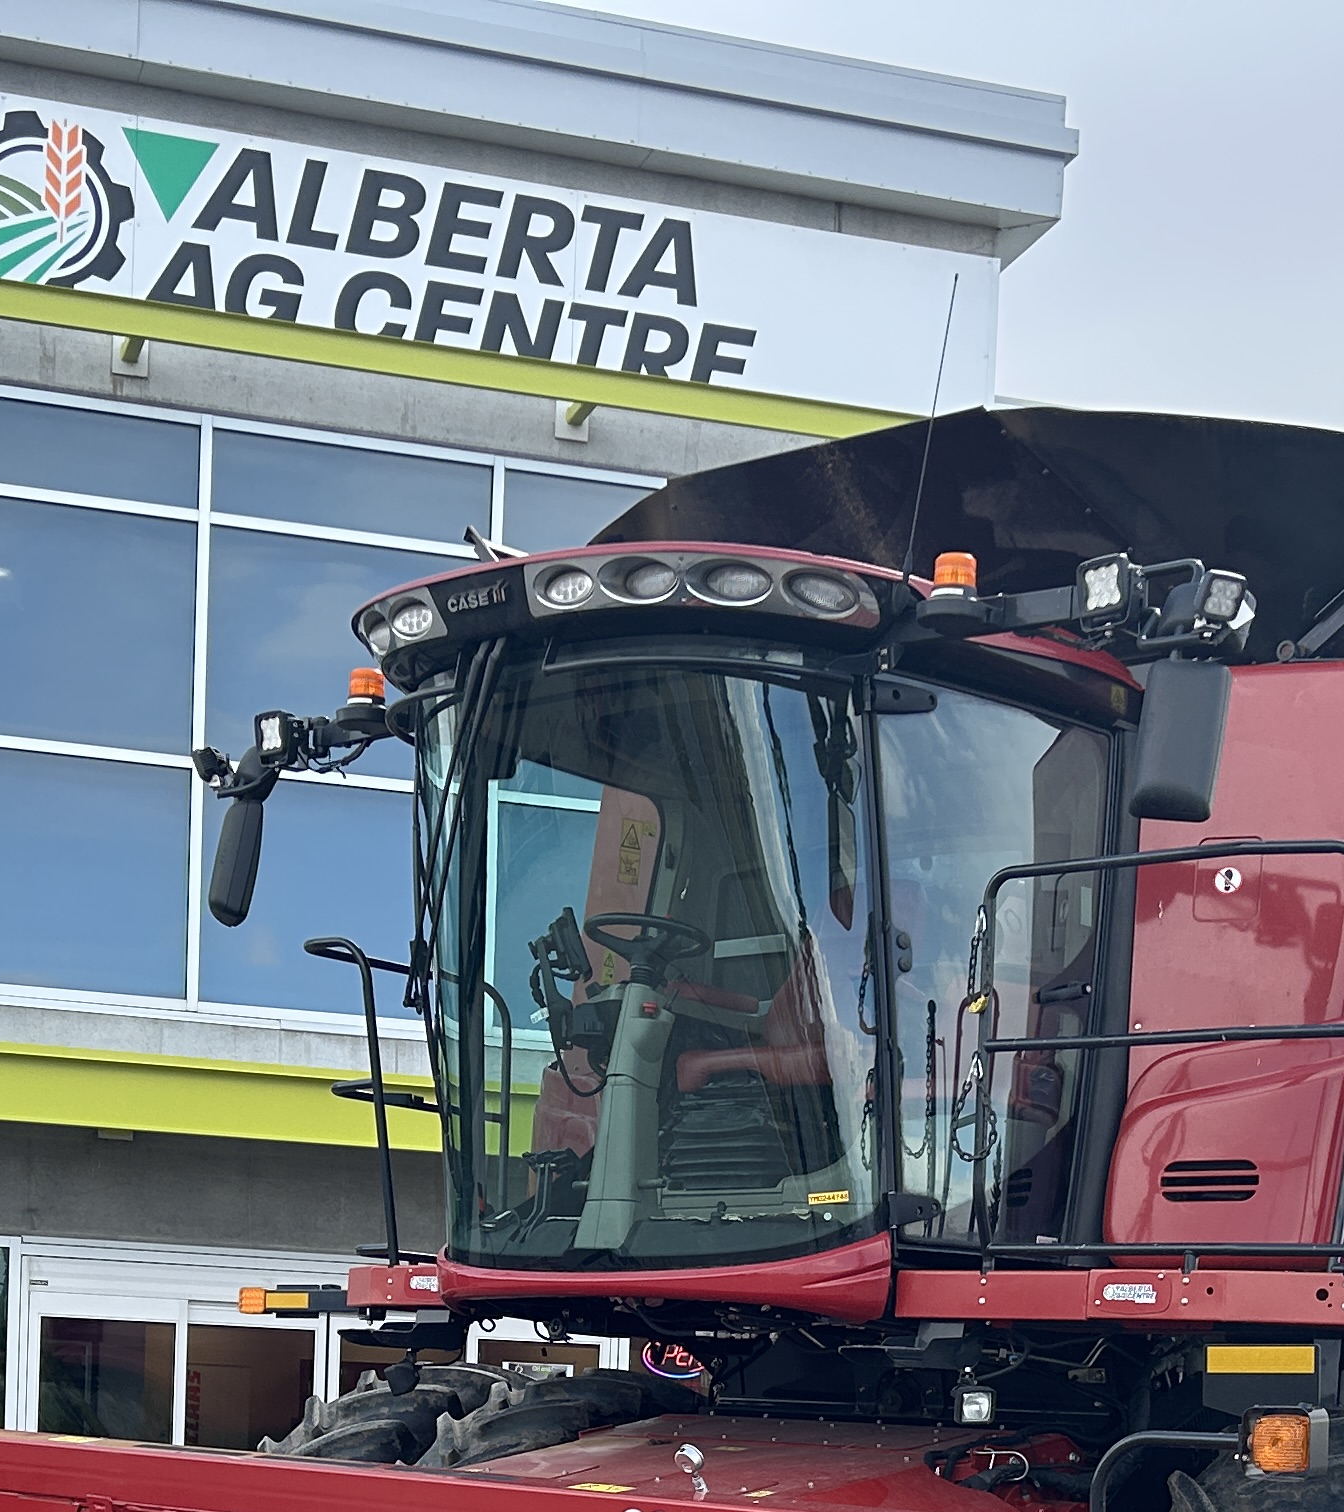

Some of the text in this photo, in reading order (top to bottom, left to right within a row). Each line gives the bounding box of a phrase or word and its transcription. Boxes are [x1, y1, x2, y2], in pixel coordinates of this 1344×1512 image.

[192, 148, 700, 307] ALBERTA
[145, 243, 757, 384] AG CENTRE
[447, 588, 490, 613] CASE
